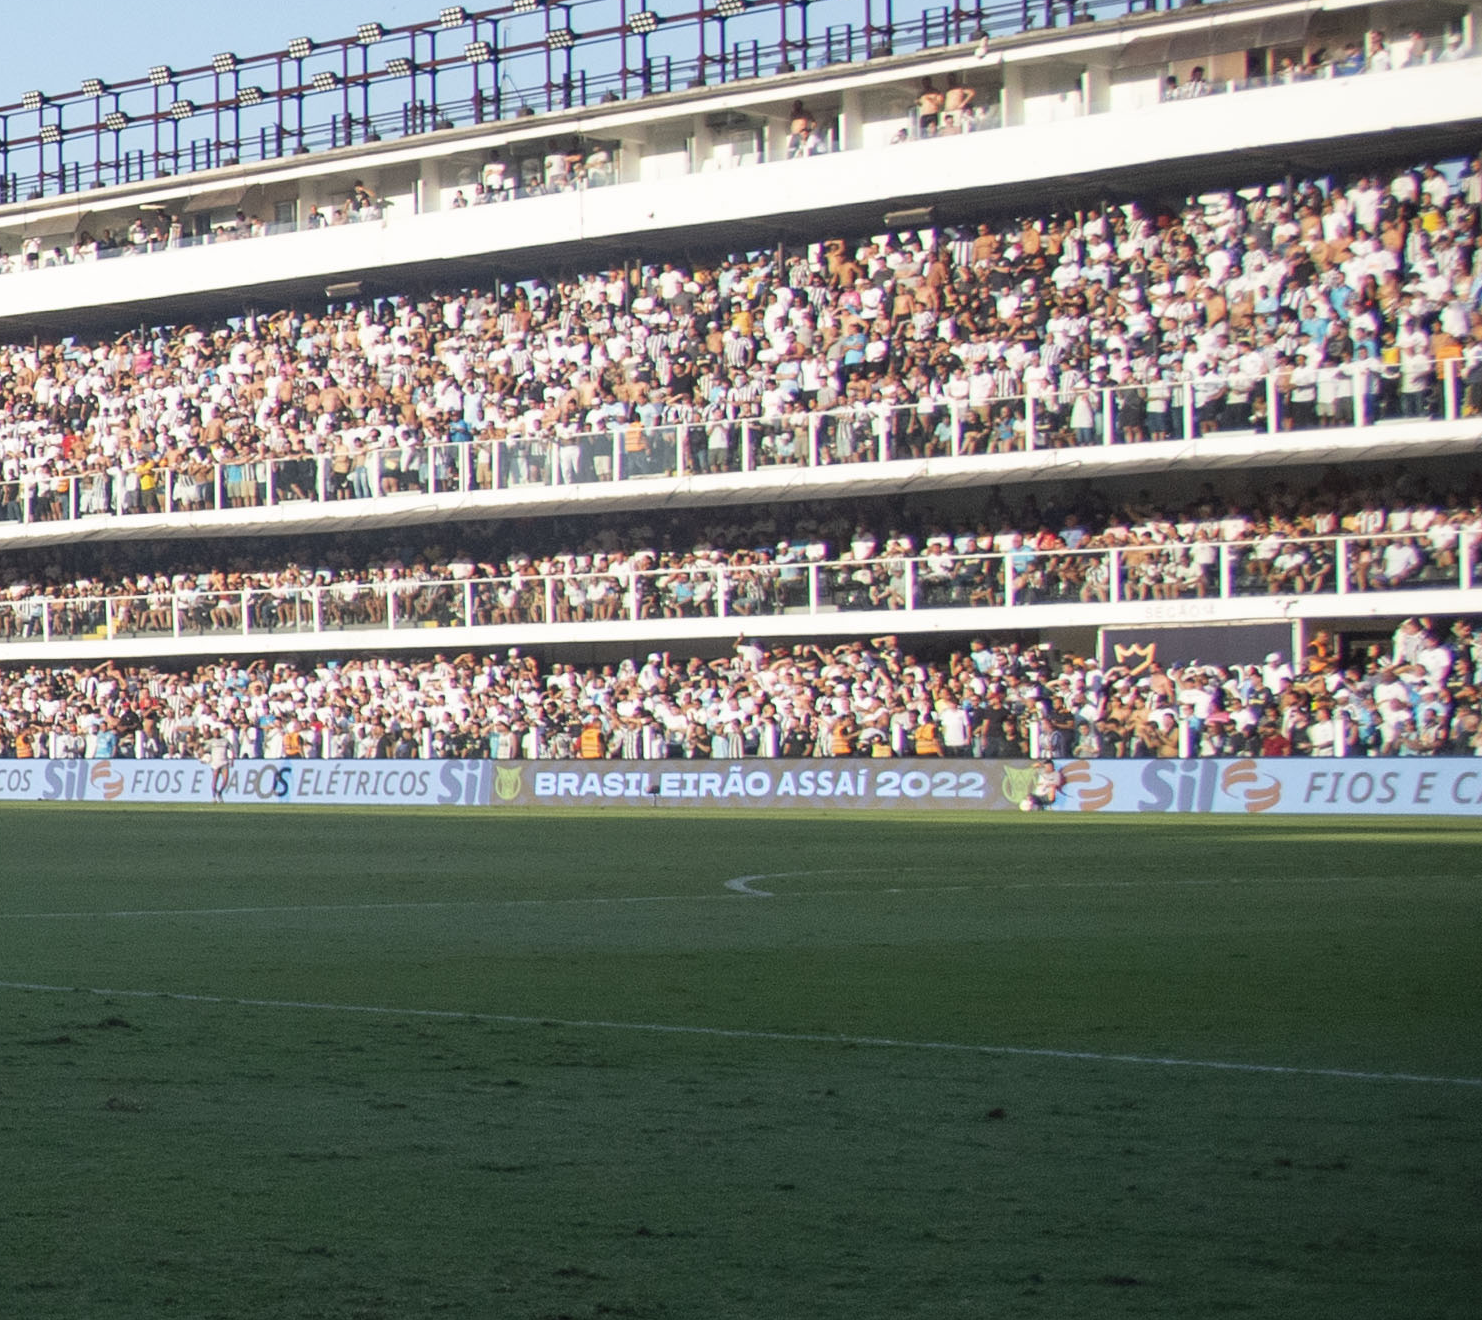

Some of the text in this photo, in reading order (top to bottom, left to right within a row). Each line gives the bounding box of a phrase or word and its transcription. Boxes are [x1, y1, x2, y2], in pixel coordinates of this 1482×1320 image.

[43, 759, 90, 800] Sil
[131, 763, 431, 799] FIOS E ABOS ELÉTRICOS
[437, 759, 491, 805] Sil
[534, 765, 985, 798] BRASILEIRÃO ASSAÍ 2022
[1138, 759, 1218, 812] Sil
[1305, 771, 1399, 804] FIOS
[1413, 771, 1438, 804] E
